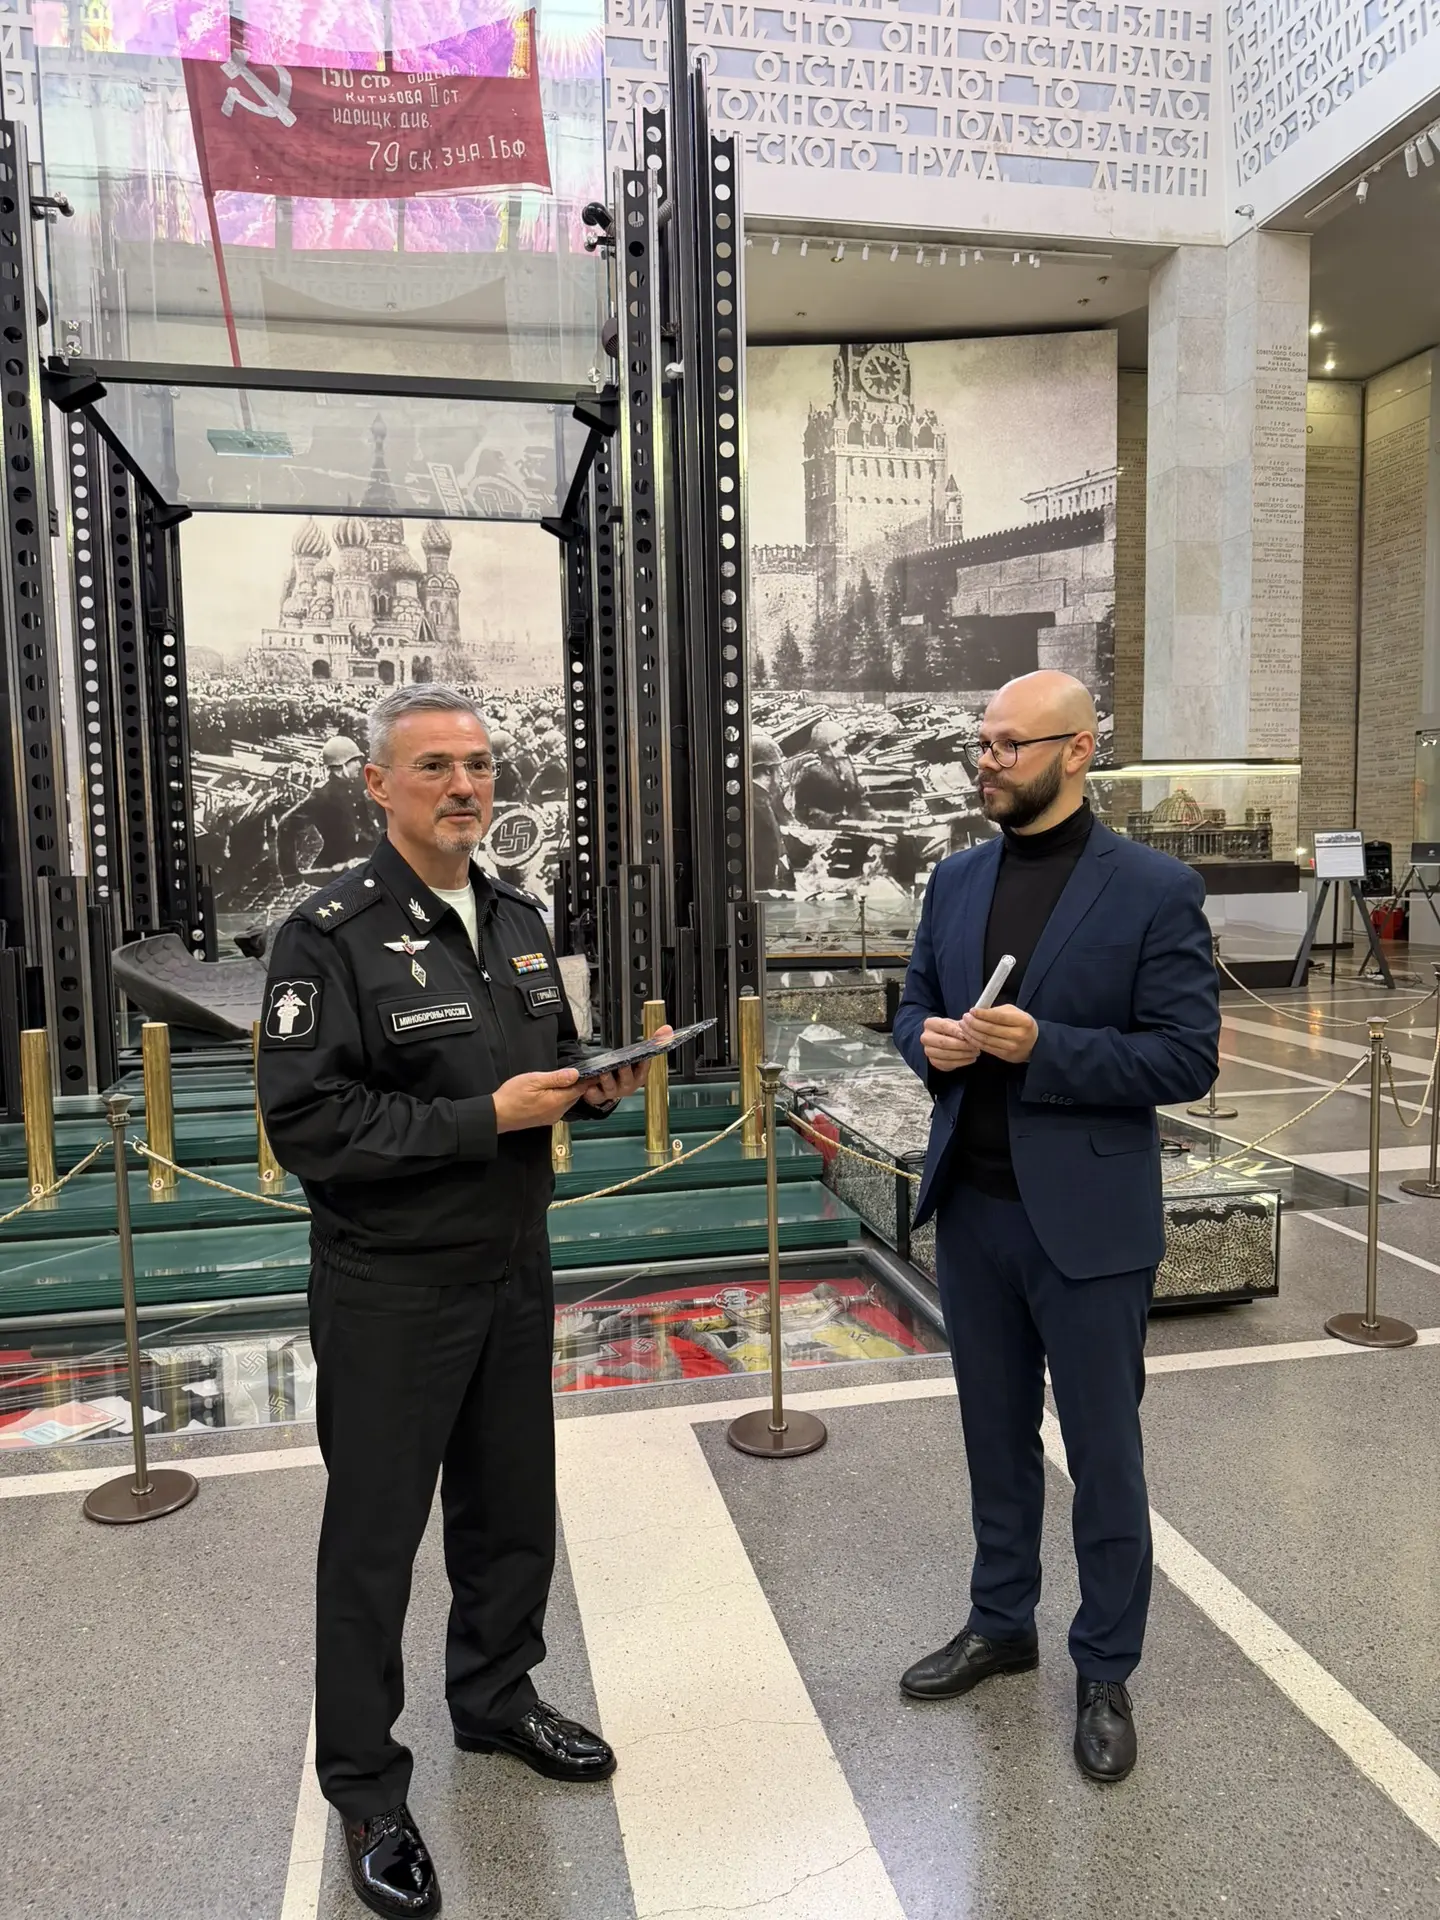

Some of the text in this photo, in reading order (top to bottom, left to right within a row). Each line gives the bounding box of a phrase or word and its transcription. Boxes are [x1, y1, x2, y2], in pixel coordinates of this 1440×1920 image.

[1000, 0, 1211, 43] КРЕСТЬЯНЕ
[782, 9, 852, 48] ЧТО
[882, 20, 958, 57] ОНИ
[984, 31, 1211, 84] ОТСТАИВАЮТ
[642, 39, 718, 76] ЧО
[754, 51, 1006, 103] ОТСТАИВАЮТ
[1033, 76, 1081, 109] ТО
[333, 107, 433, 130] ИДРИЦК. ДИВ.
[937, 106, 1206, 159] ПОЛЬЗОВАТЬСЯ
[366, 141, 400, 172] 79
[409, 150, 438, 170] С.К.
[1089, 161, 1208, 197] ЛЕНИН
[399, 1007, 467, 1027] МИНОБОРОНЫ РОССИИ
[33, 1185, 41, 1195] 2
[154, 1179, 162, 1188] 3
